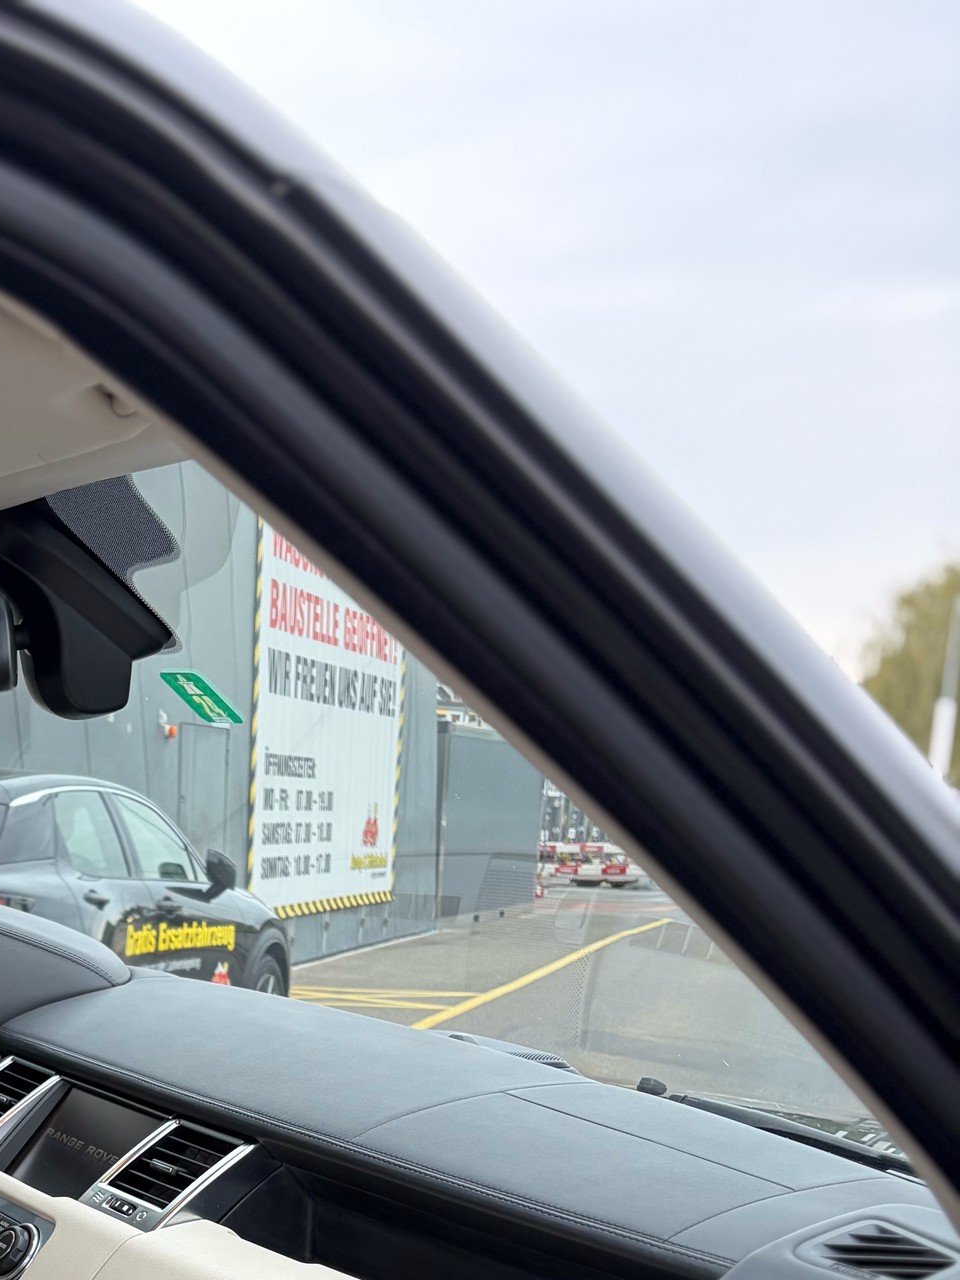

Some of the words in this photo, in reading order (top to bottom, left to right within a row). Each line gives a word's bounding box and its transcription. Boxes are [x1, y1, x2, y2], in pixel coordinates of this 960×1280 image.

[269, 577, 340, 647] BAUSTELLE
[293, 654, 338, 707] FREUEN
[46, 1127, 85, 1152] RANGE
[86, 1145, 120, 1165] ROVE
